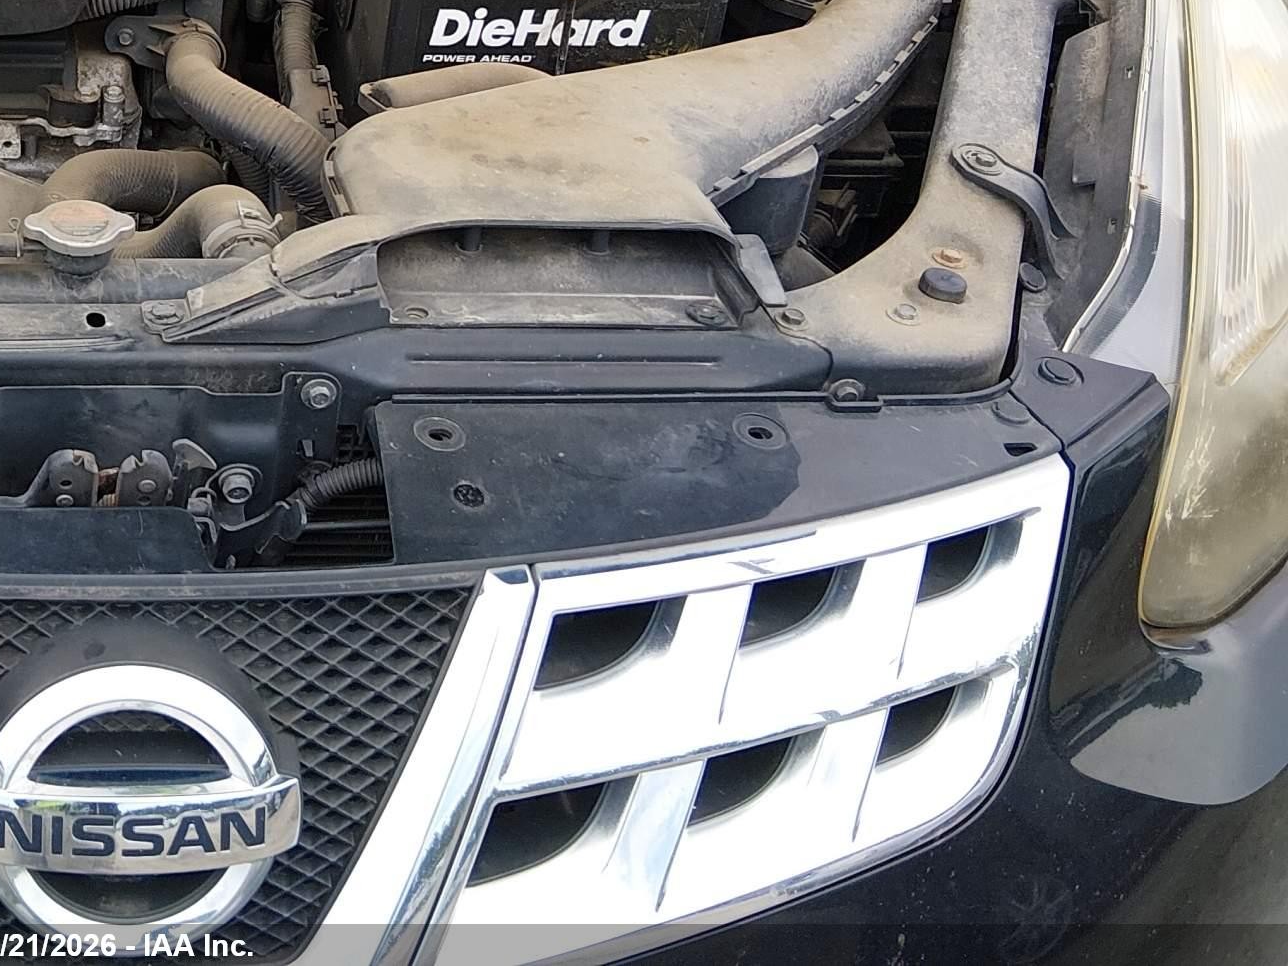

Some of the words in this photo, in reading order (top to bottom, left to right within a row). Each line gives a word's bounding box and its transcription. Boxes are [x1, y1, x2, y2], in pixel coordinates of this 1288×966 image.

[428, 7, 651, 47] DieHard
[422, 54, 480, 63] POWER
[480, 54, 533, 63] AHEAD
